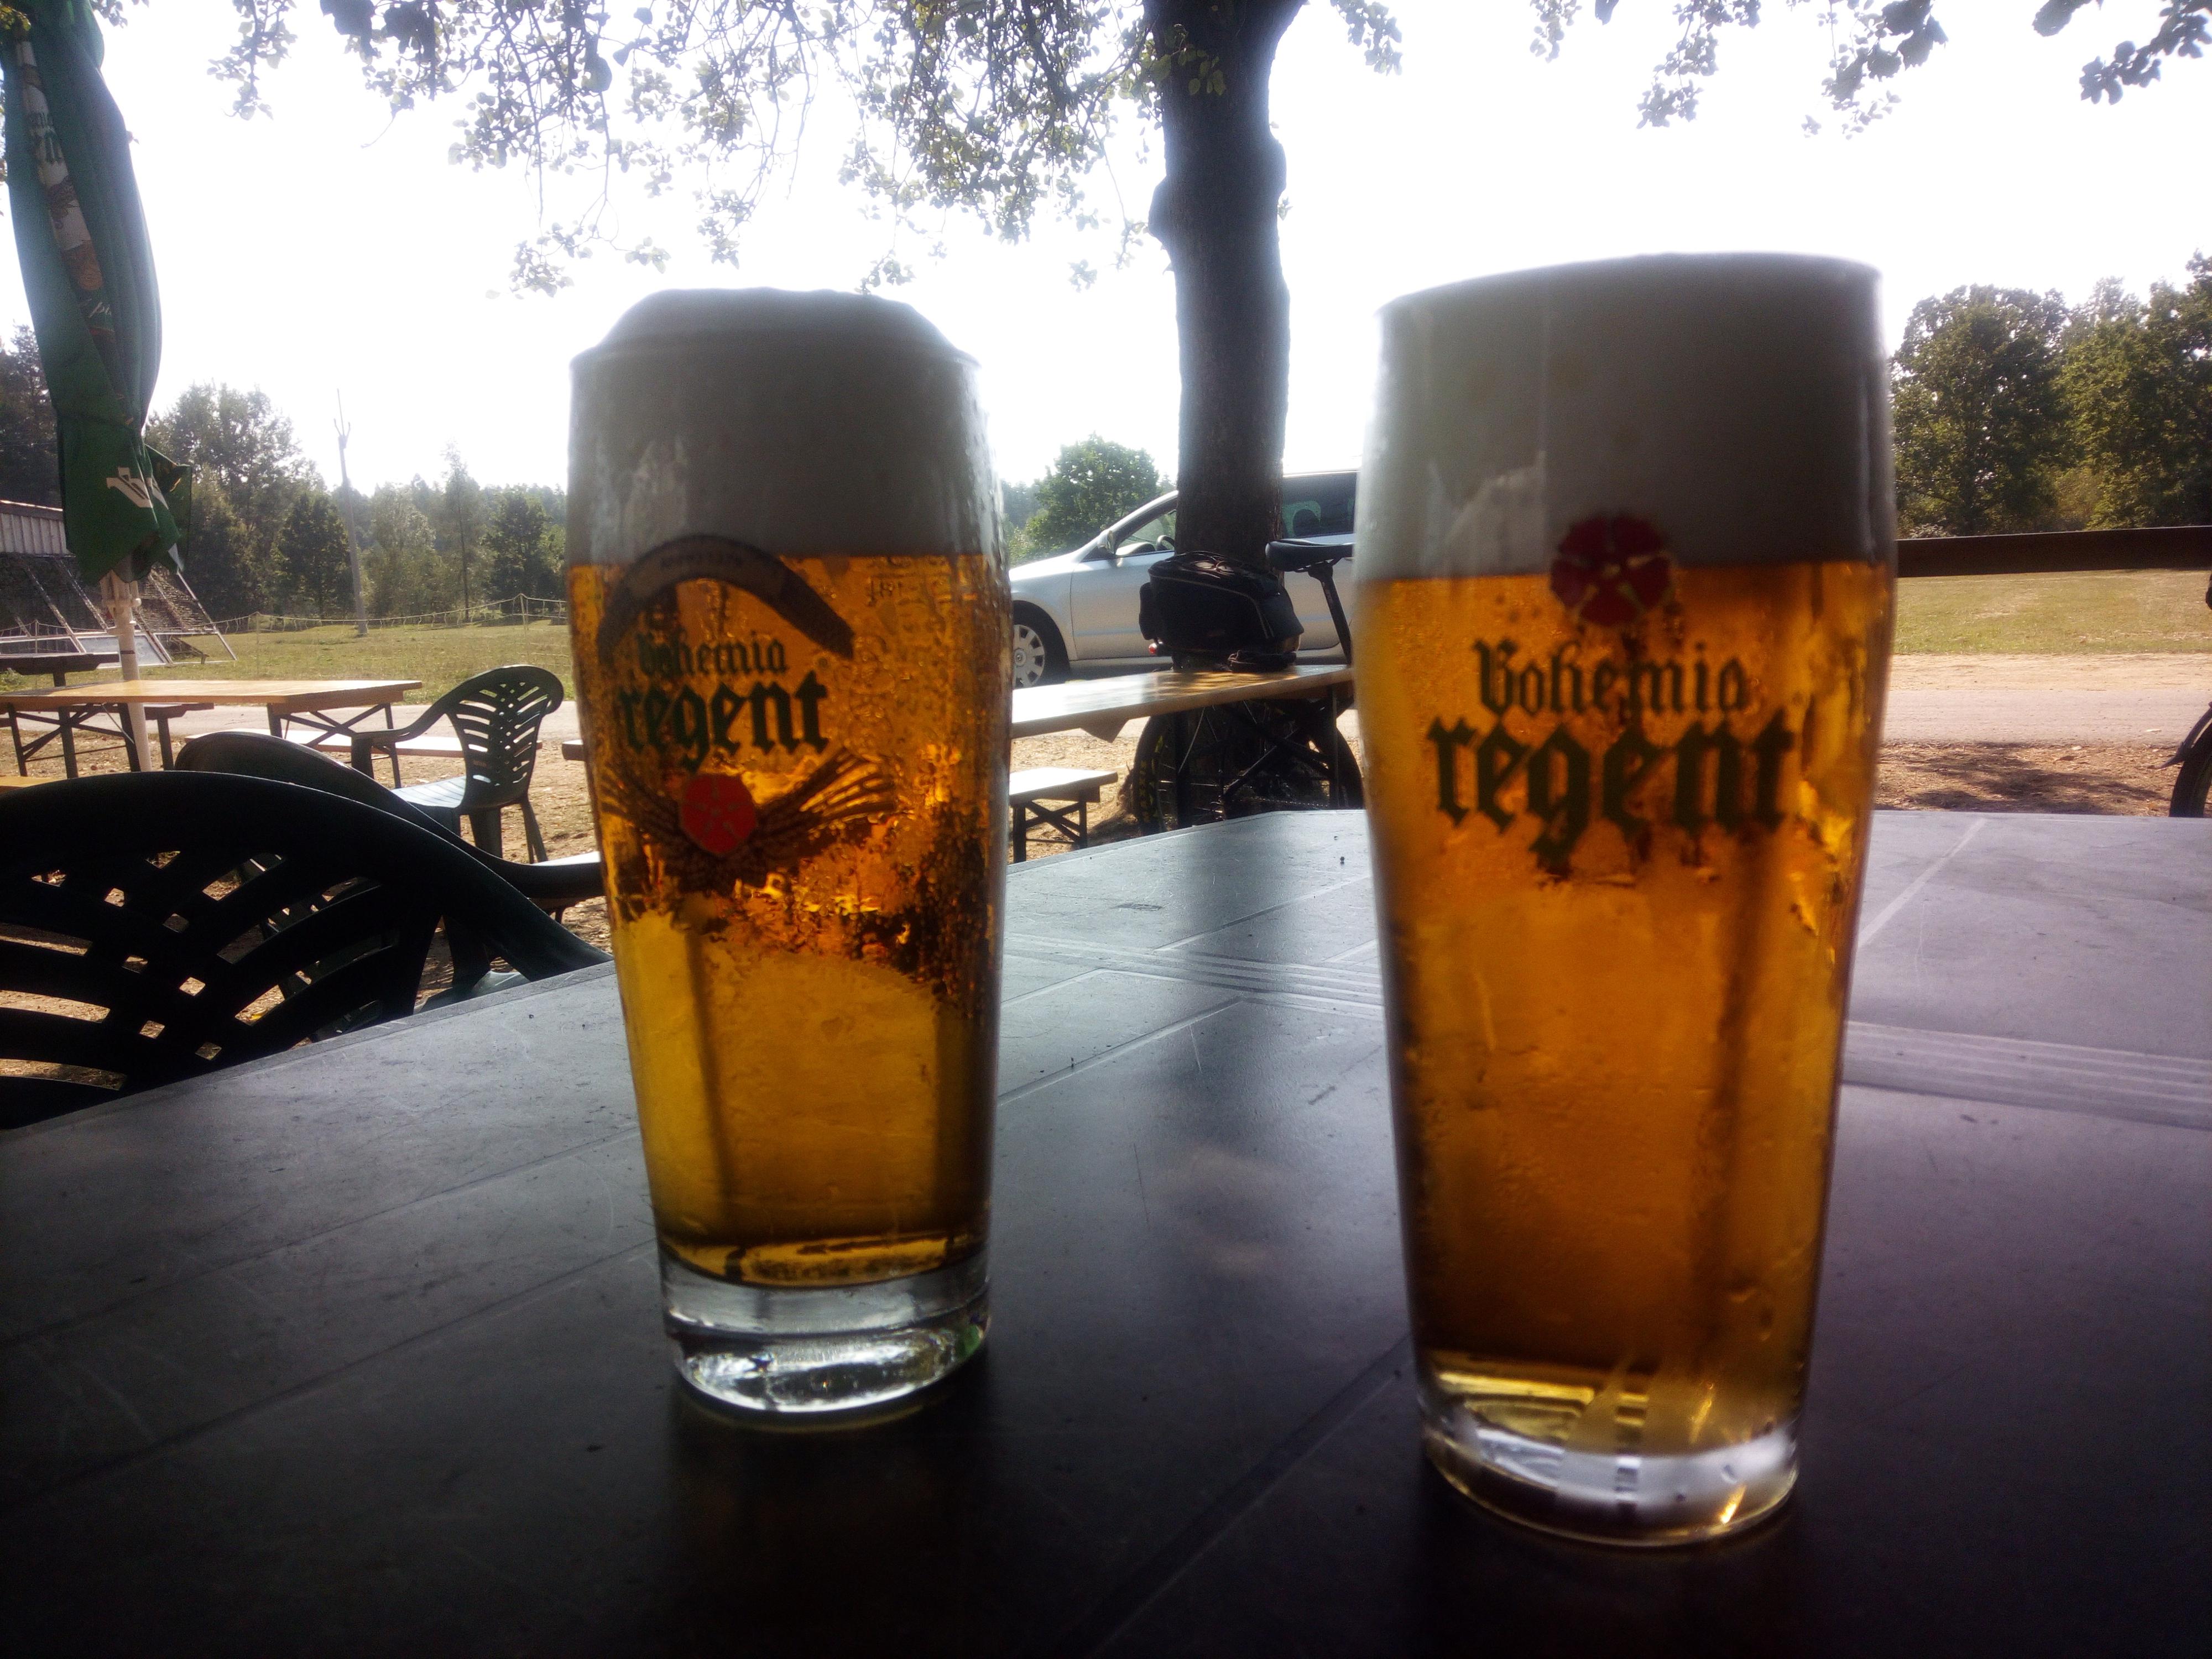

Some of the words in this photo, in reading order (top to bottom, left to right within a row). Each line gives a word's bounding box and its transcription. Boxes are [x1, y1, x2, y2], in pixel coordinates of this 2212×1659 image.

[617, 671, 829, 772] regent
[1472, 637, 1750, 716] Bohemia
[1427, 707, 1795, 866] regent
